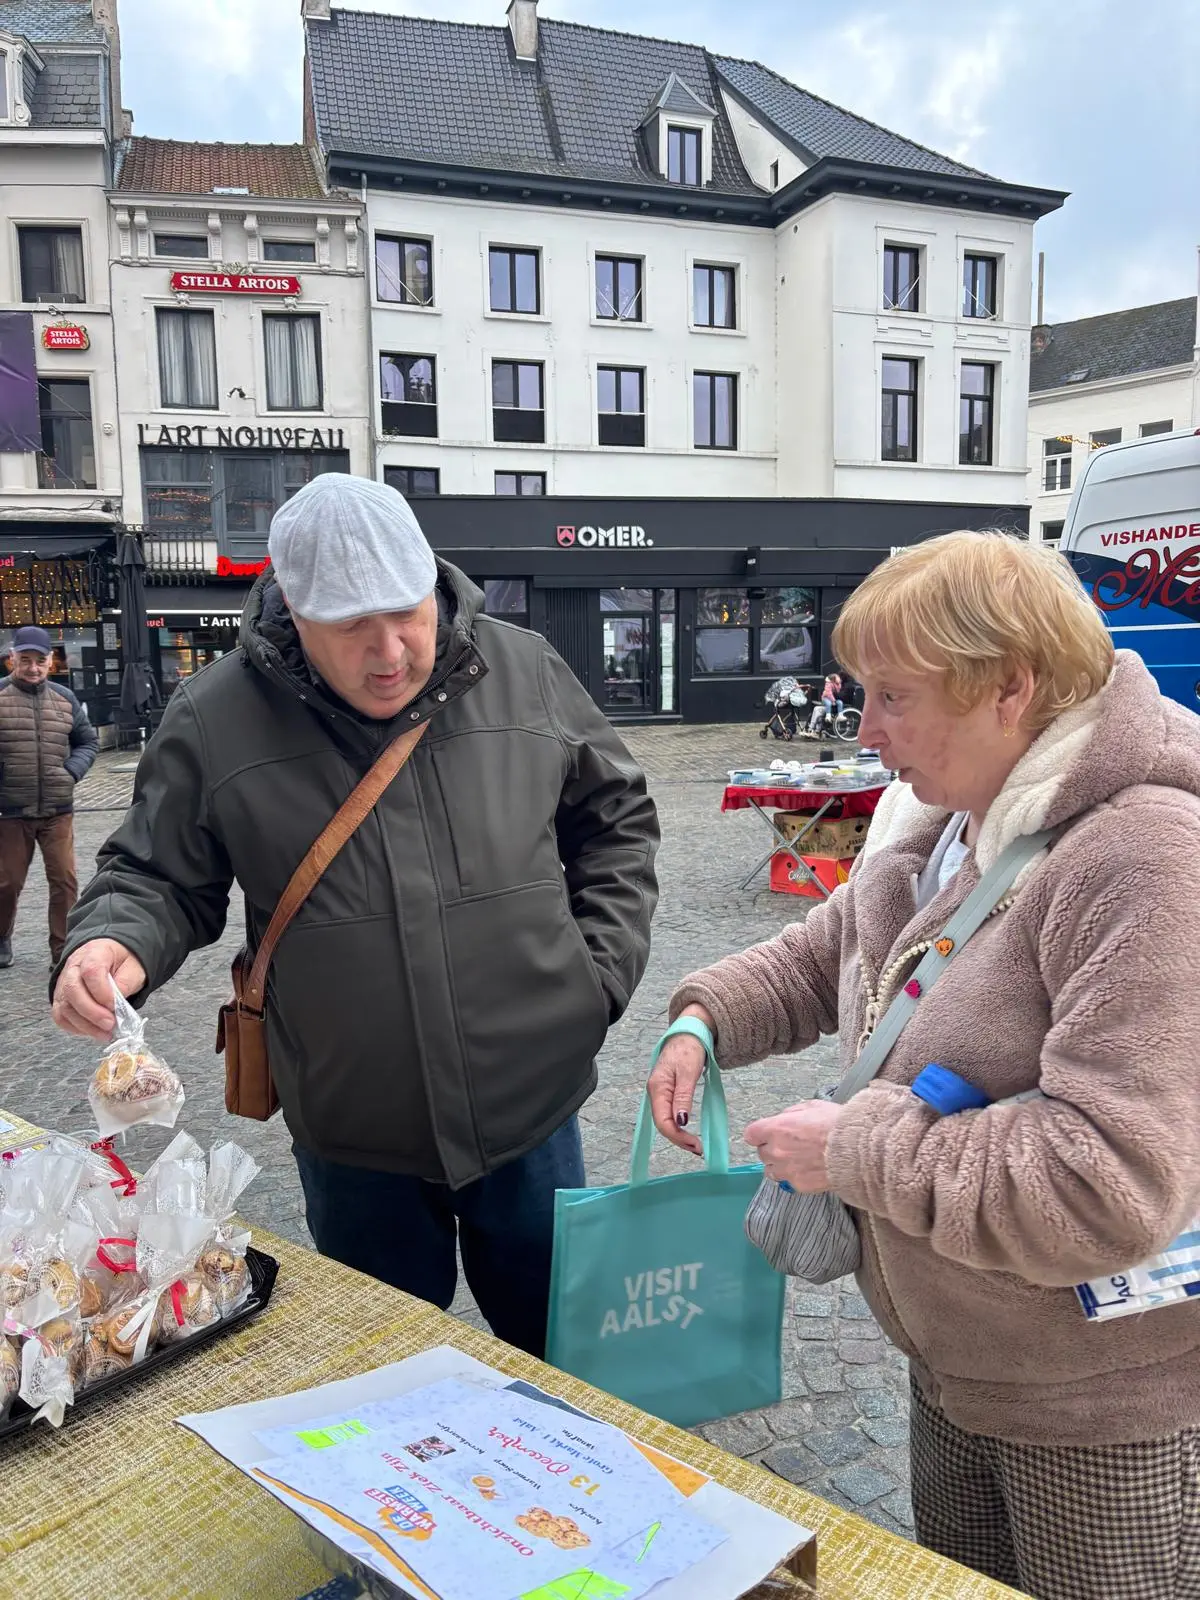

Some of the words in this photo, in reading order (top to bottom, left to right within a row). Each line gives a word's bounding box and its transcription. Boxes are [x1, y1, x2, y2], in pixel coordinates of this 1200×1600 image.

[180, 275, 233, 289] STELLA
[238, 278, 290, 291] ARTOIS
[50, 330, 80, 338] STELLA
[51, 337, 81, 345] ARTOIS
[215, 425, 344, 449] NOUVEAU
[577, 526, 655, 547] OMER.
[211, 617, 229, 627] Art
[624, 1262, 704, 1302] VISIT
[600, 1294, 704, 1339] AALST
[381, 1451, 410, 1473] Zijn
[488, 1426, 571, 1476] December
[582, 1455, 614, 1475] Grote
[408, 1471, 444, 1493] Ziek
[569, 1475, 600, 1496] 13
[387, 1485, 424, 1512] WEEK
[366, 1489, 435, 1531] WARMSTE
[391, 1514, 417, 1531] DE
[441, 1494, 534, 1556] Onzichtbaar
